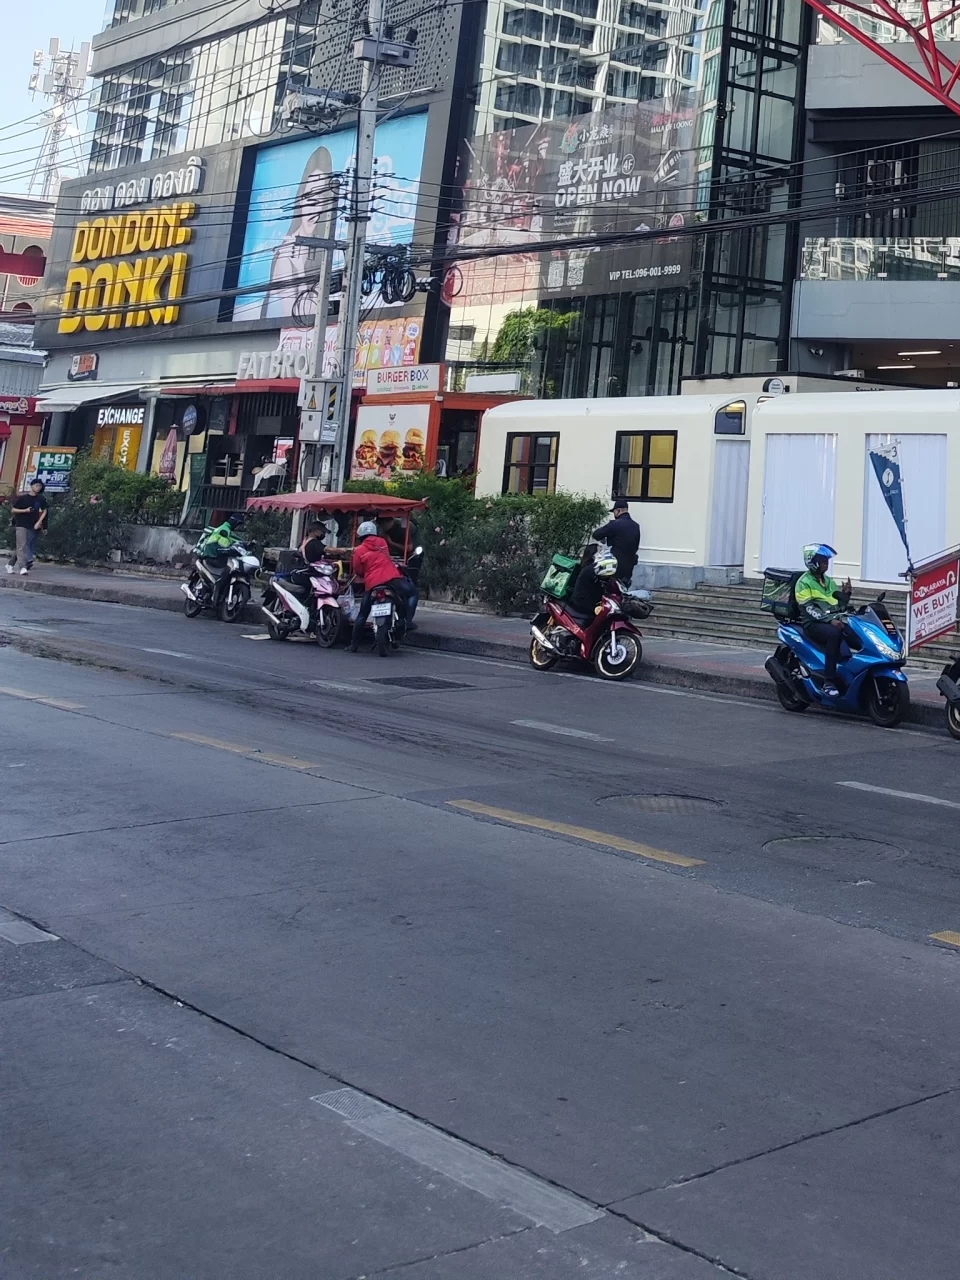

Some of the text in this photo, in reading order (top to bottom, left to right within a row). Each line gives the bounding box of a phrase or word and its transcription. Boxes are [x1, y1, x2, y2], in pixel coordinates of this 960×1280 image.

[557, 152, 619, 186] 盛大开业
[622, 158, 634, 171] 4F
[80, 186, 113, 214] ดอง
[115, 178, 149, 208] ดอง
[555, 176, 642, 208] OPEN NOW
[609, 265, 681, 281] VIP TEL:096-001-9999
[58, 252, 187, 334] DONKI
[377, 369, 429, 384] BURGER BOX
[97, 406, 145, 427] EXCHANGE
[913, 602, 930, 619] WE
[932, 590, 955, 611] BUY!
